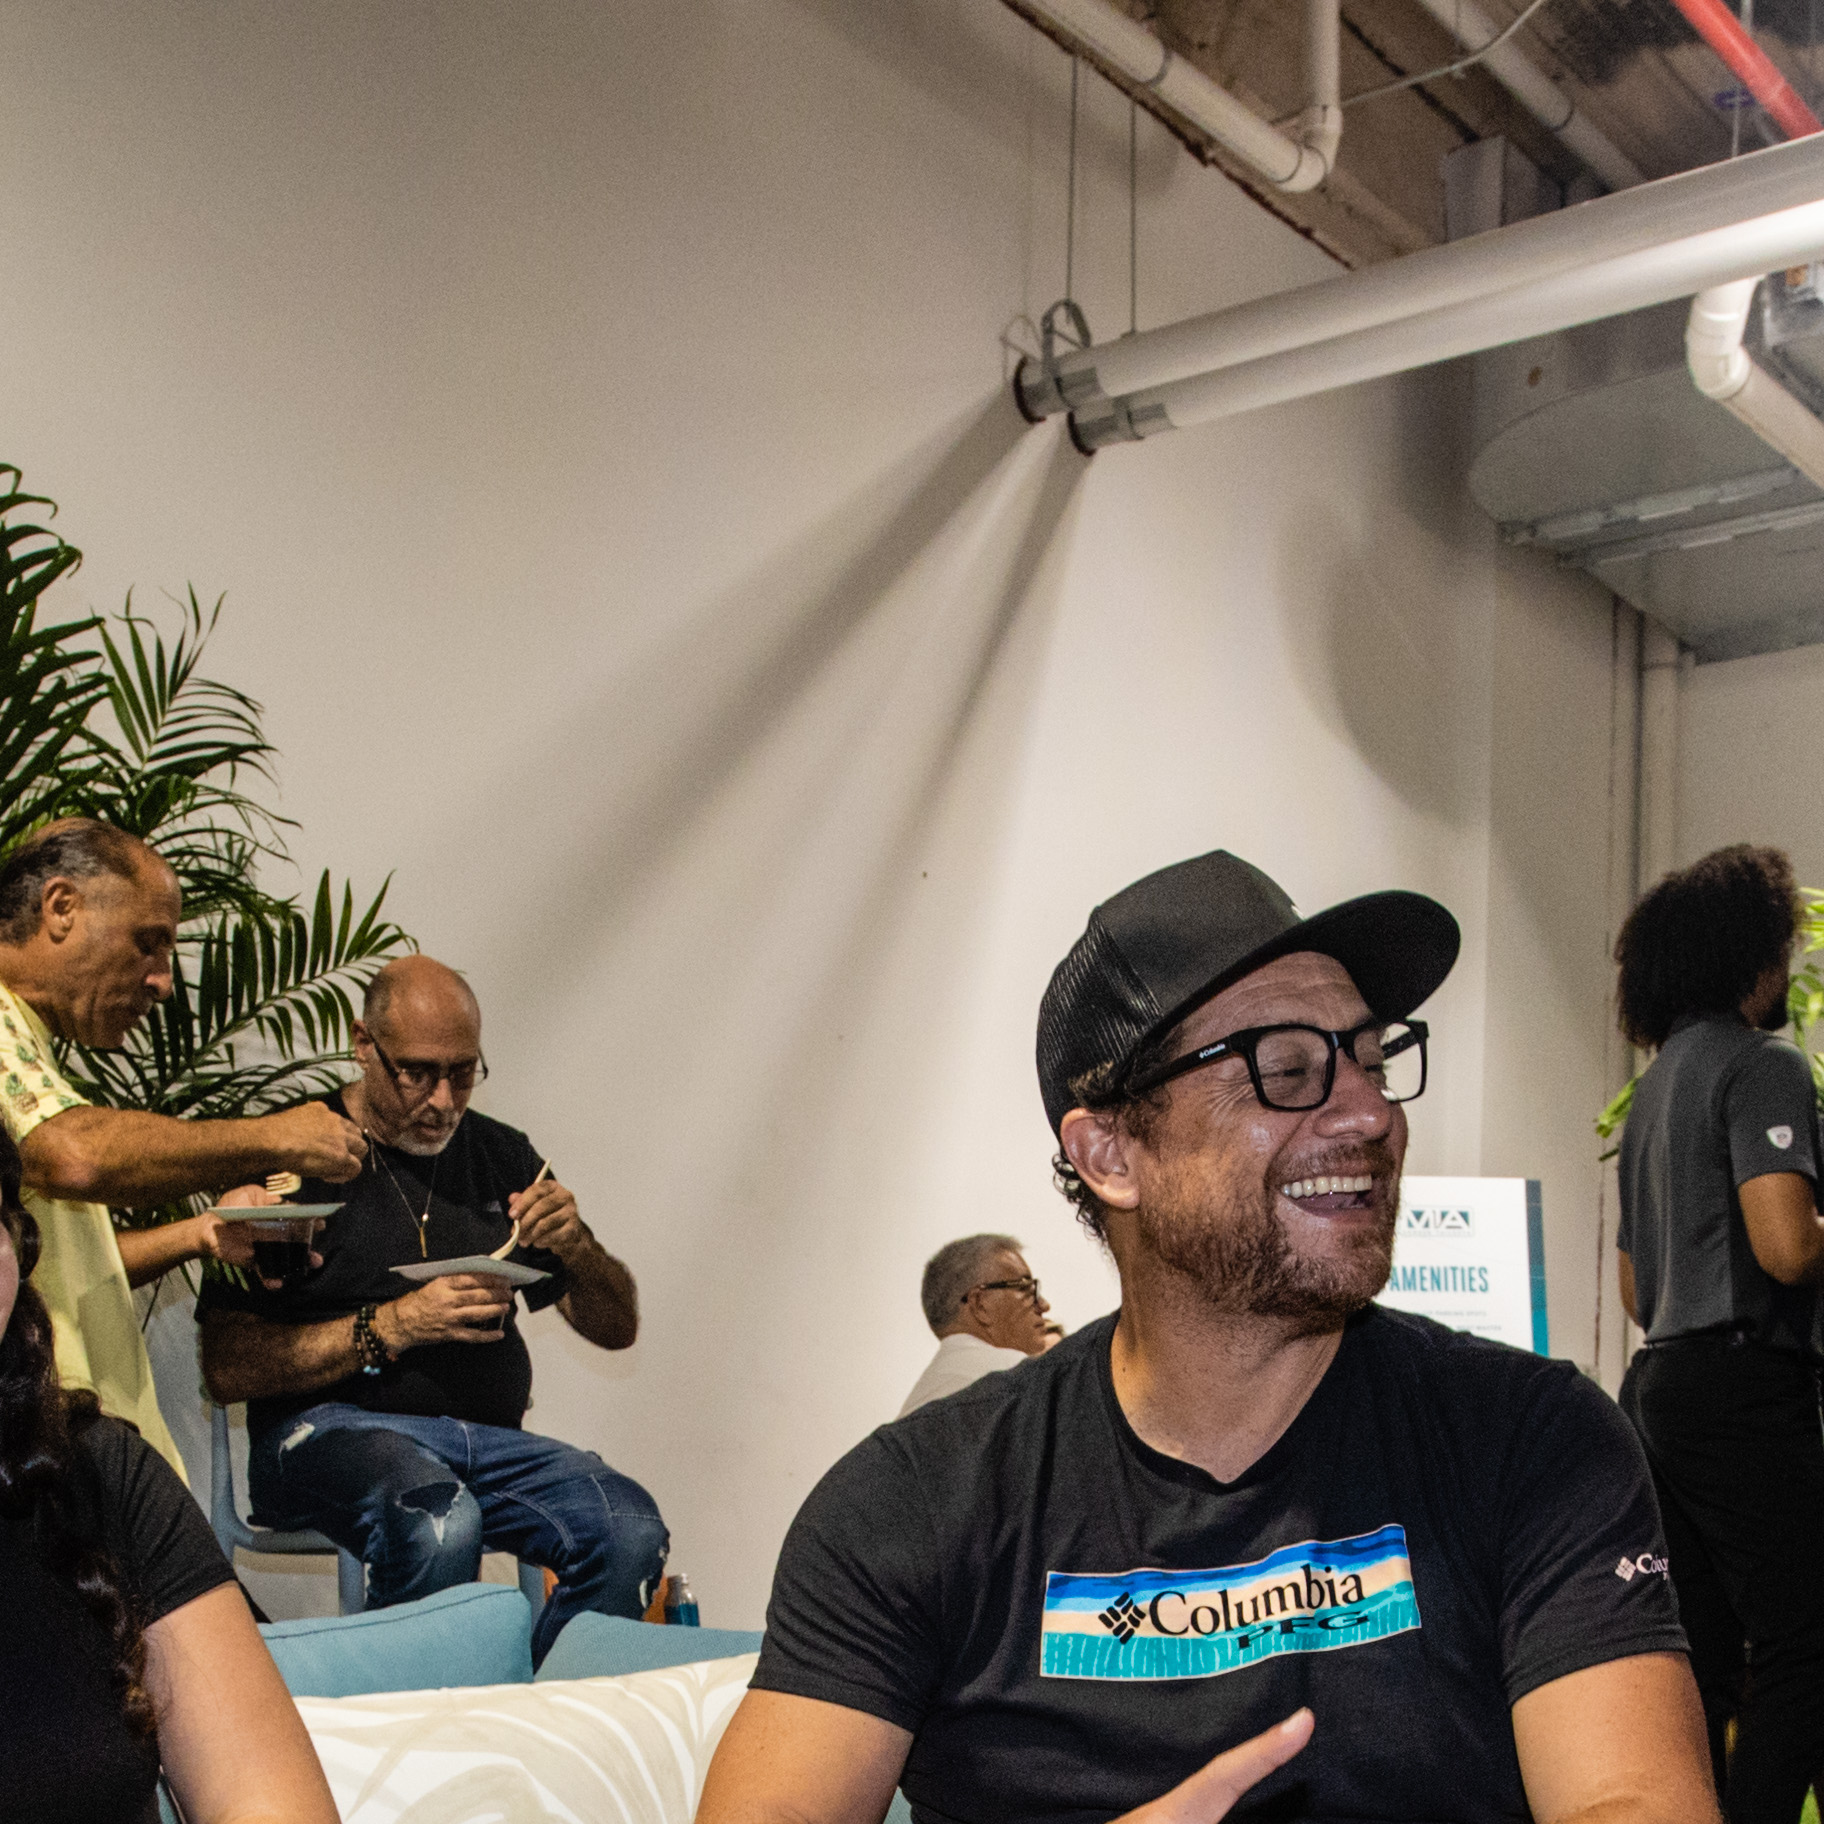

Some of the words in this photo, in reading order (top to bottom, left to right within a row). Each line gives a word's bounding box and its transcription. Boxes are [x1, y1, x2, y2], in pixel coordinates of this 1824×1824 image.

[1389, 1265, 1489, 1293] AMENITIES
[1149, 1563, 1367, 1636] Columbia
[1237, 1610, 1370, 1650] PFG
